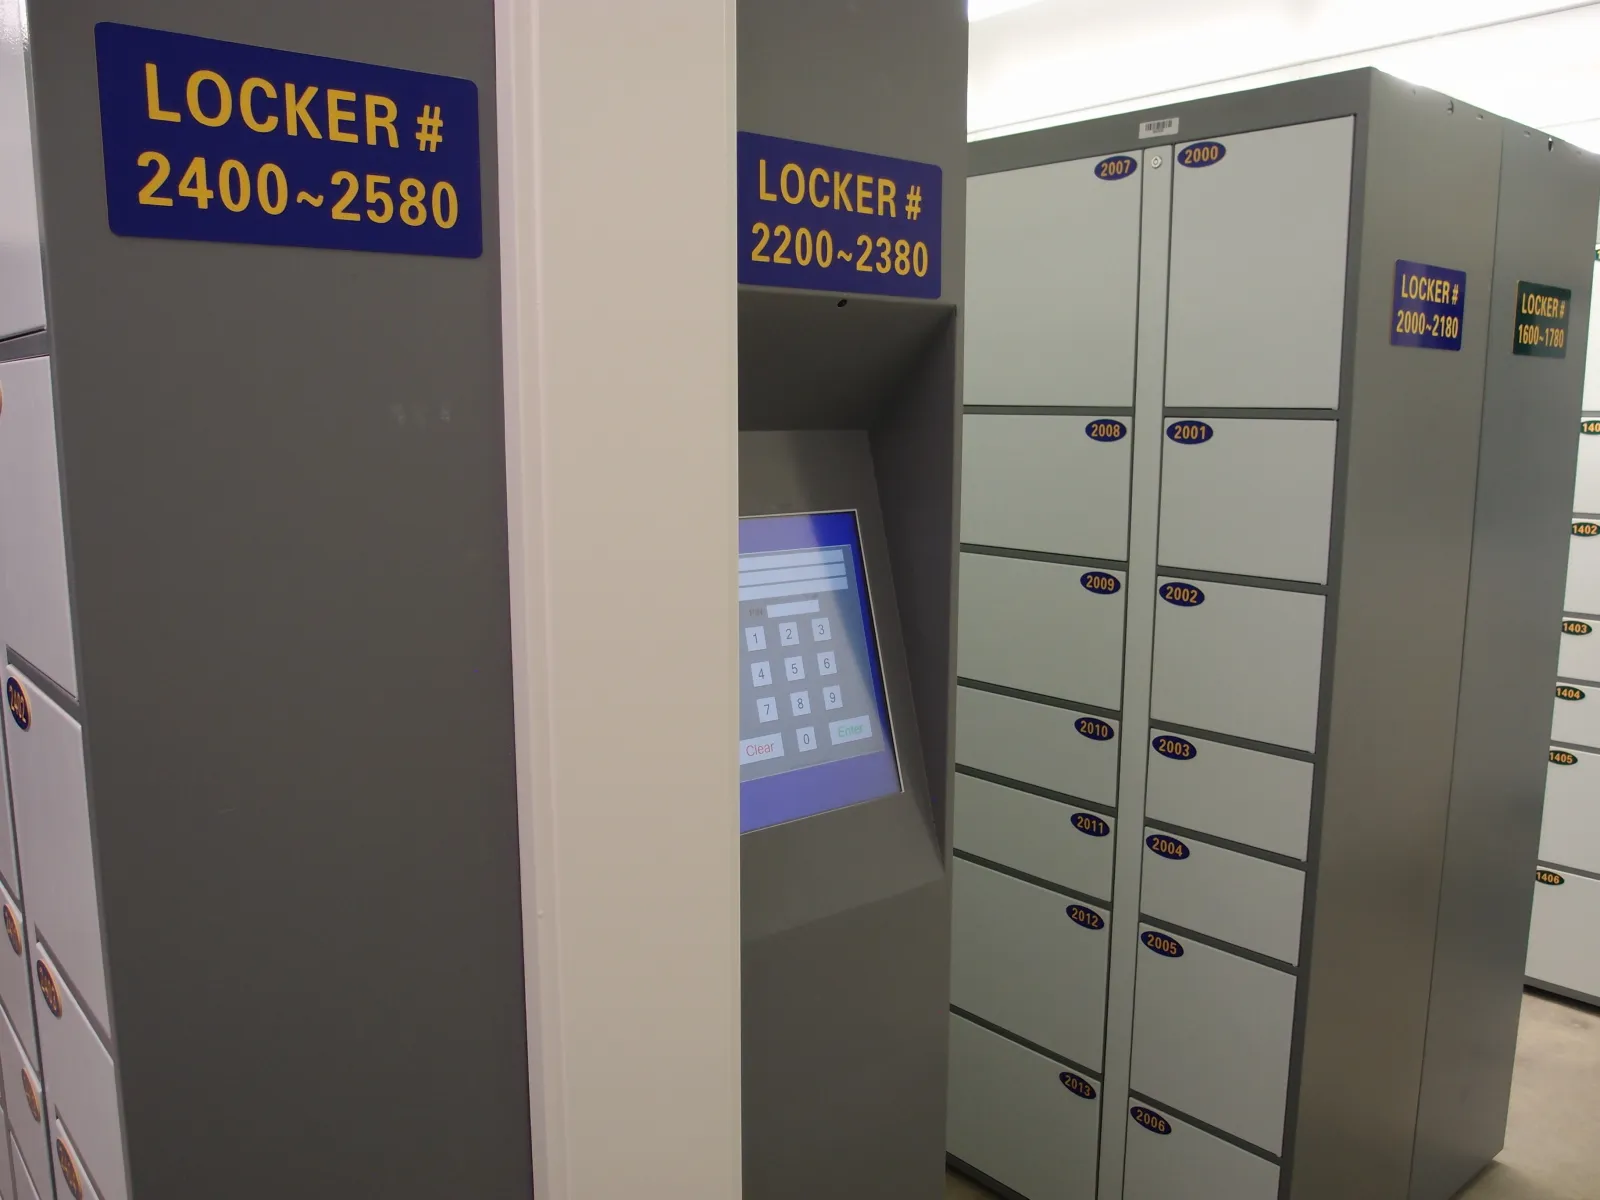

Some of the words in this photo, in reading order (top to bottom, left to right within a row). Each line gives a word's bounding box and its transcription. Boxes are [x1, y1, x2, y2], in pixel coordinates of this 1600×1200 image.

[145, 62, 400, 148] LOCKER
[415, 104, 443, 152] #
[1184, 146, 1219, 164] 2000
[1100, 159, 1131, 177] 2007
[137, 151, 459, 229] 2400~2580
[759, 159, 897, 218] LOCKER
[905, 185, 922, 220] #
[751, 222, 929, 277] 2200~2380
[1401, 274, 1450, 304] LOCKER
[1451, 284, 1459, 305] #
[1521, 292, 1559, 318] LOCKER
[1559, 301, 1565, 319] #
[1396, 310, 1459, 339] 2000~2180
[1518, 323, 1565, 348] 1600~1780
[1091, 424, 1121, 438] 2008
[1174, 425, 1206, 440] 2001
[1572, 525, 1597, 535] 1402
[1086, 575, 1115, 591] 2009
[1166, 586, 1198, 603] 2002
[752, 633, 759, 644] 1
[785, 629, 793, 640] 2
[817, 624, 825, 635] 3
[1563, 623, 1587, 634] 1403
[758, 668, 765, 680] 4
[791, 663, 799, 675] 5
[823, 658, 831, 669] 6
[764, 704, 770, 715] 7
[797, 698, 804, 709] 8
[829, 692, 836, 703] 9
[1556, 687, 1580, 700] 1404
[1080, 720, 1108, 738] 2010
[746, 741, 775, 757] Clear
[803, 733, 810, 745] 0
[837, 723, 864, 738] Enter
[1159, 738, 1190, 757] 2003
[1550, 752, 1573, 764] 1405
[1076, 816, 1104, 834] 2011
[1152, 837, 1183, 857] 2004
[1536, 871, 1560, 884] 1406
[1071, 907, 1100, 928] 2012
[1146, 934, 1177, 955] 2005
[1064, 1074, 1091, 1097] 2013
[1136, 1108, 1165, 1132] 2006
